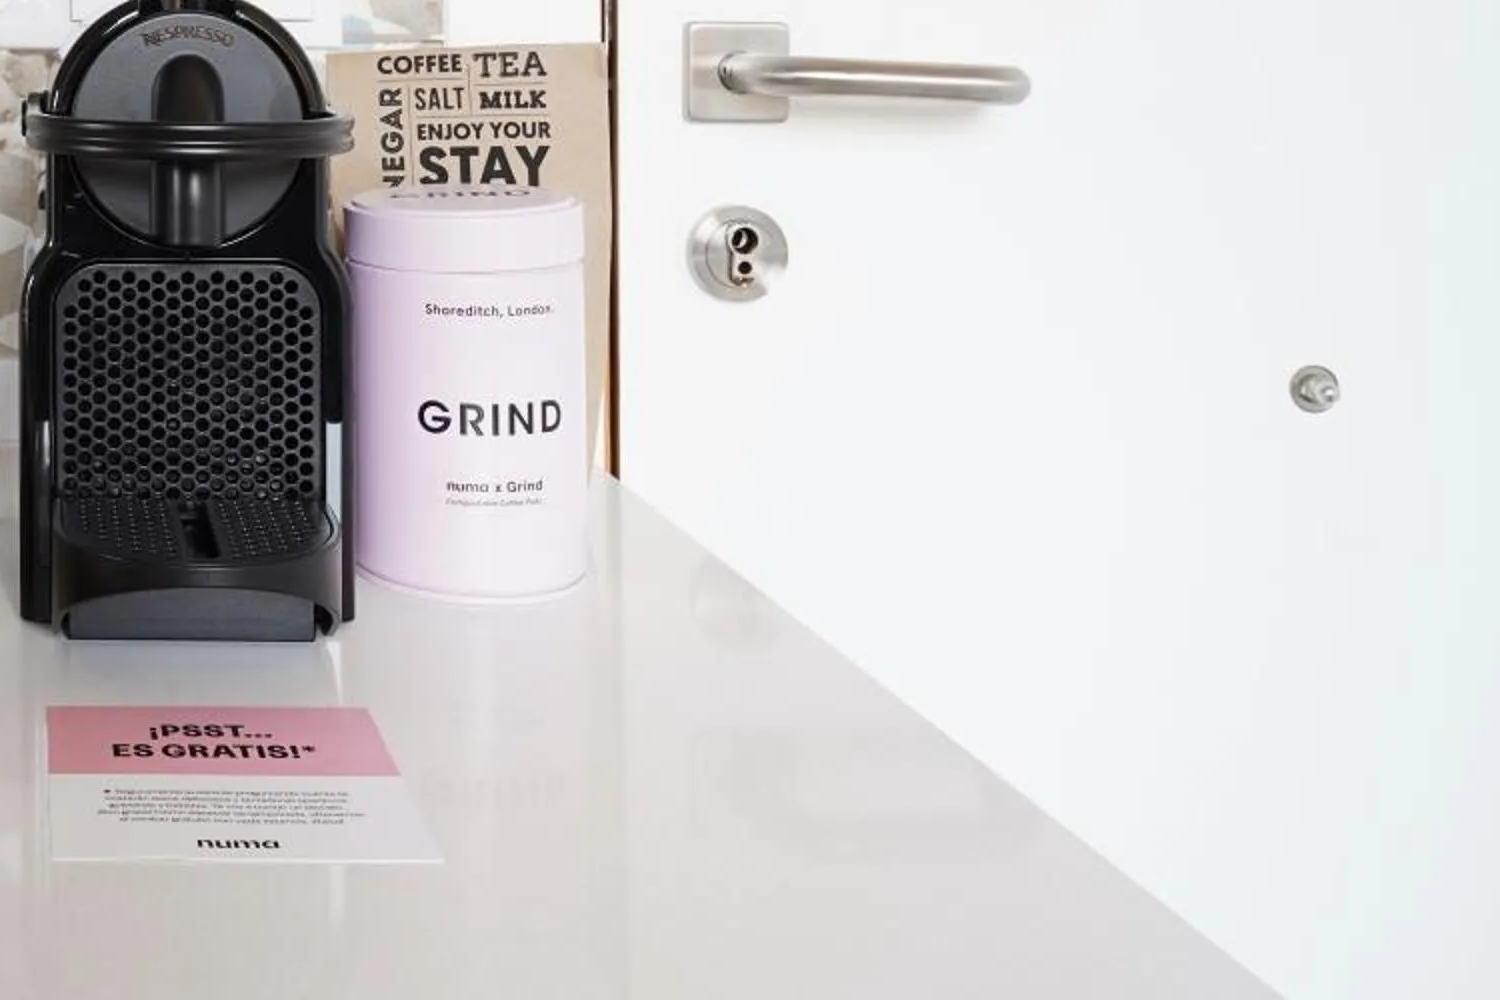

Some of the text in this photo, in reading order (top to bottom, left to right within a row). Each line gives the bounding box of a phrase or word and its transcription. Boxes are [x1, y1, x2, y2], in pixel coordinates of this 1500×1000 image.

[140, 25, 235, 47] NESPRESSO
[376, 53, 463, 75] COFFEE
[472, 51, 548, 78] TEA
[414, 86, 465, 111] SALT
[477, 89, 547, 110] MILK
[416, 121, 551, 141] ENJOY YOUR
[419, 145, 551, 187] STAY
[425, 302, 504, 319] Shoreditch,
[417, 399, 562, 437] GRIND
[446, 481, 489, 493] numa
[505, 479, 544, 493] Grind
[148, 723, 273, 741] ¡PSST...
[111, 743, 156, 759] ES
[196, 838, 282, 850] numa
